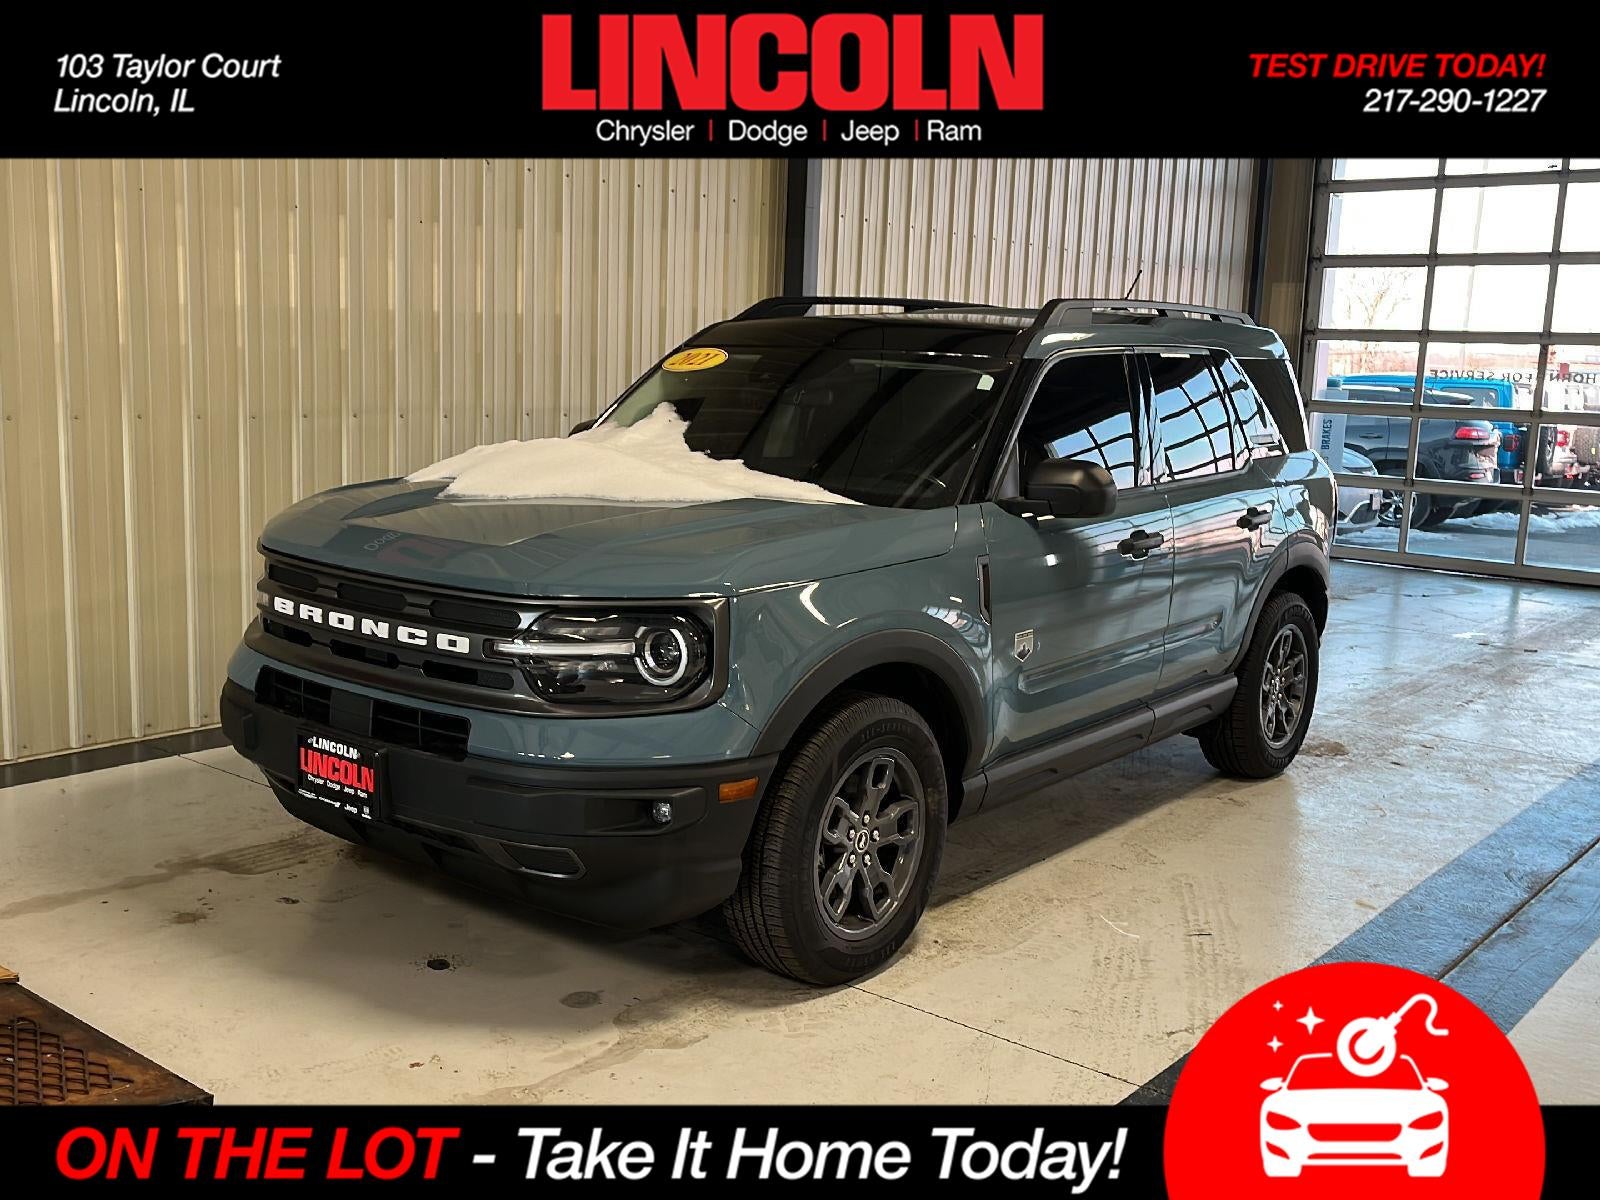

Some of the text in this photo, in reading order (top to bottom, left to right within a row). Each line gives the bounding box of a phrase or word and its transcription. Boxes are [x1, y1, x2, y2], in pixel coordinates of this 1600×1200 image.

[1321, 419, 1332, 450] BRAKES
[274, 596, 470, 654] BRONCO
[312, 736, 358, 760] LINCOLN
[300, 747, 375, 793] LINCOLN
